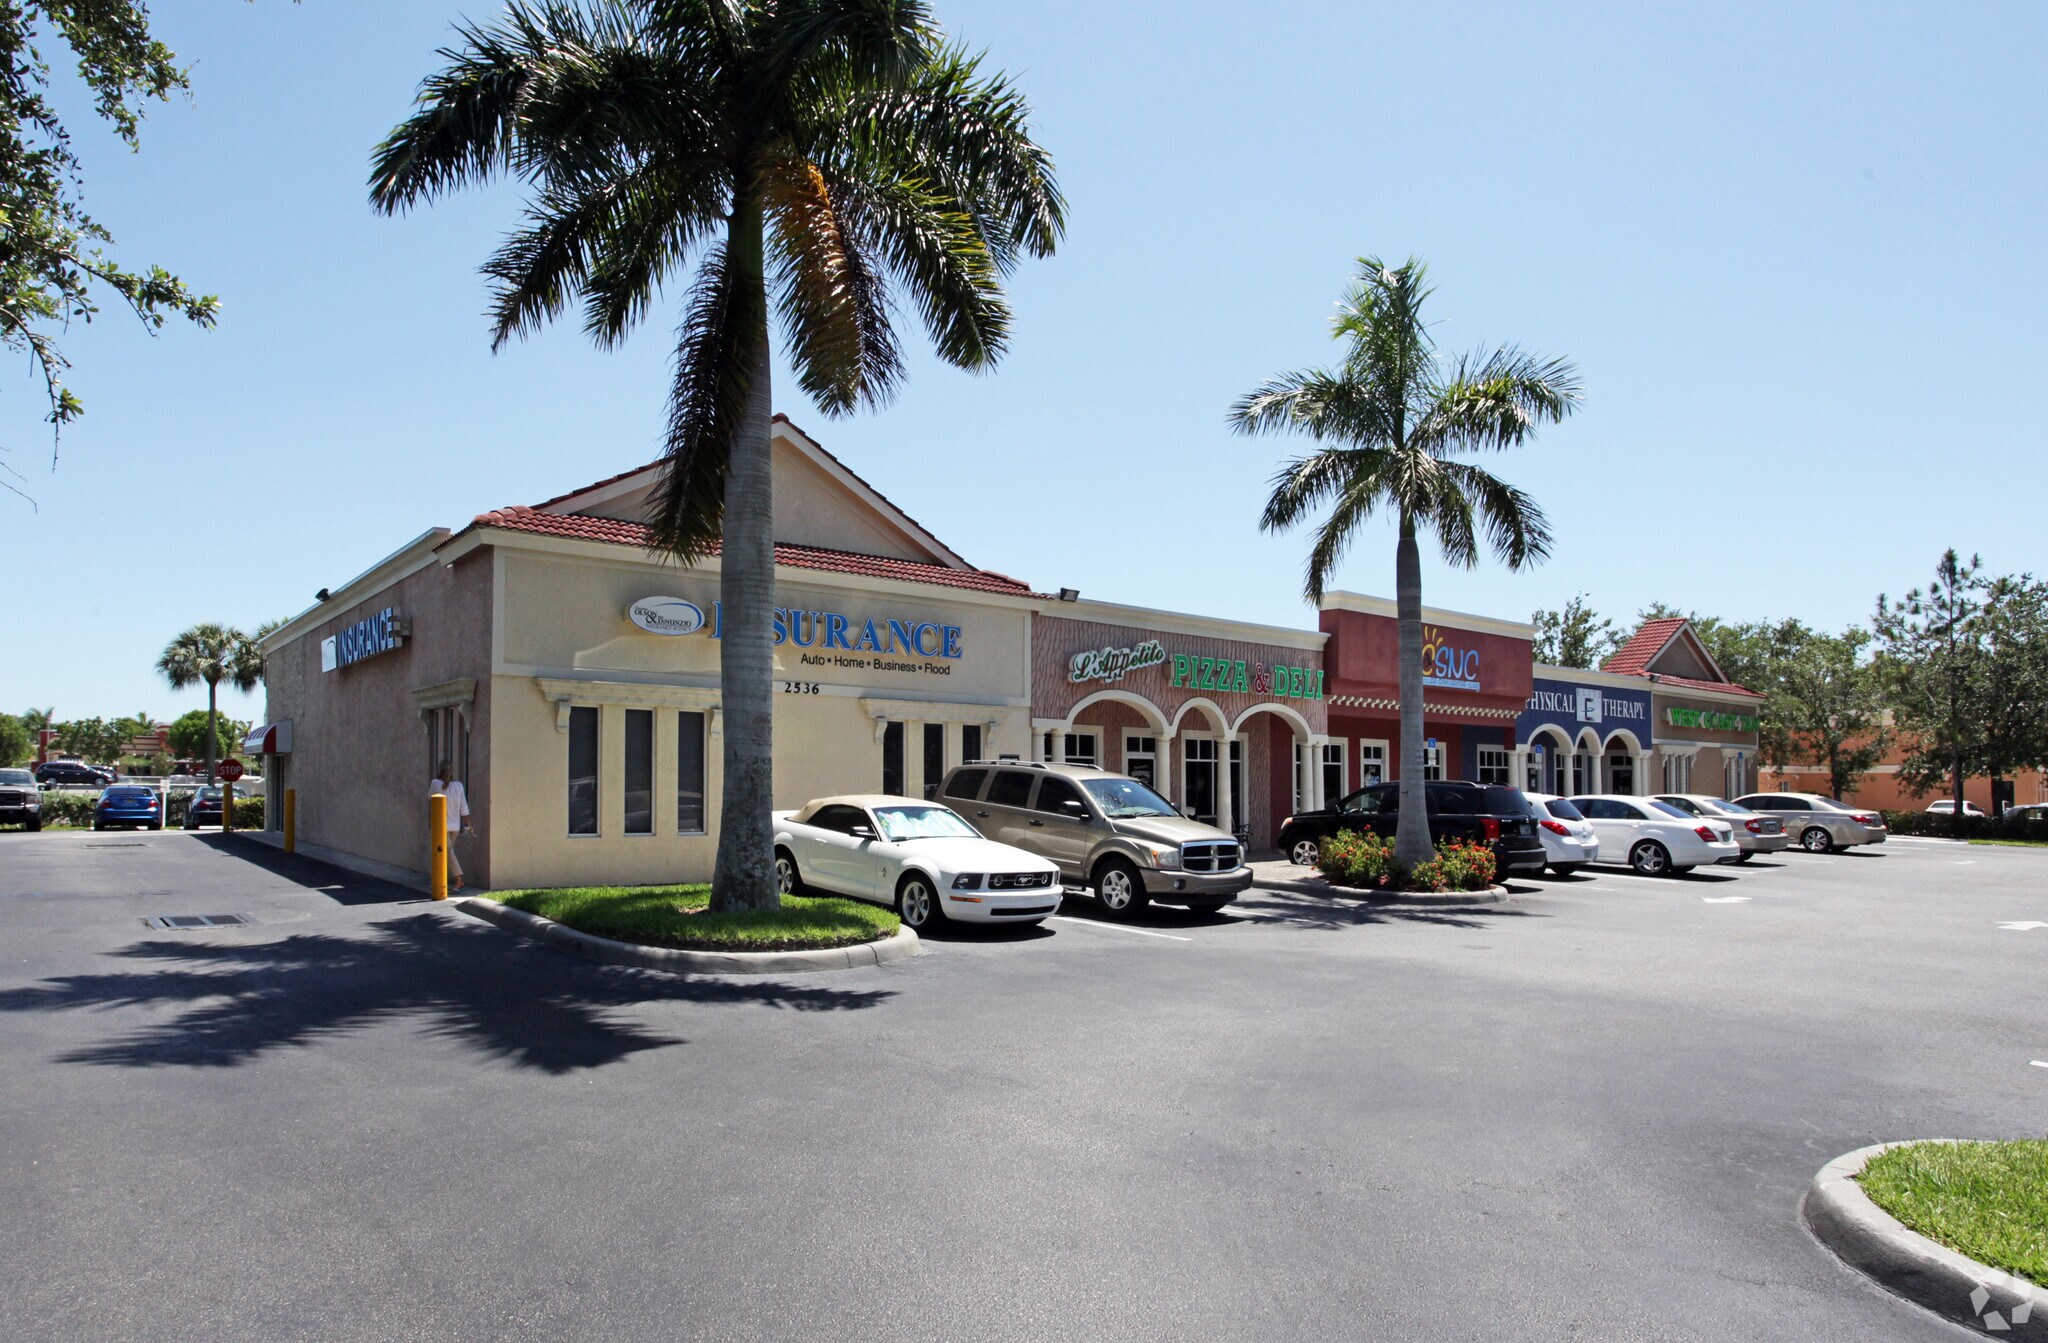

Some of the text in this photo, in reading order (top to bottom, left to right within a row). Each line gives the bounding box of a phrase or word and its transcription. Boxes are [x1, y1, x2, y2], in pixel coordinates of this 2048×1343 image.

[634, 609, 657, 618] OLSON
[339, 607, 394, 668] INSURANCE
[711, 600, 963, 660] ISURANCE
[801, 653, 951, 676] Auto Home Business Flood
[1073, 641, 1165, 681] L'Appetito
[1173, 653, 1324, 701] PIZZA & DELI
[785, 682, 820, 696] 2536
[1602, 698, 1646, 720] THERAPY
[1670, 707, 1700, 728] WEST
[219, 765, 242, 776] STOP
